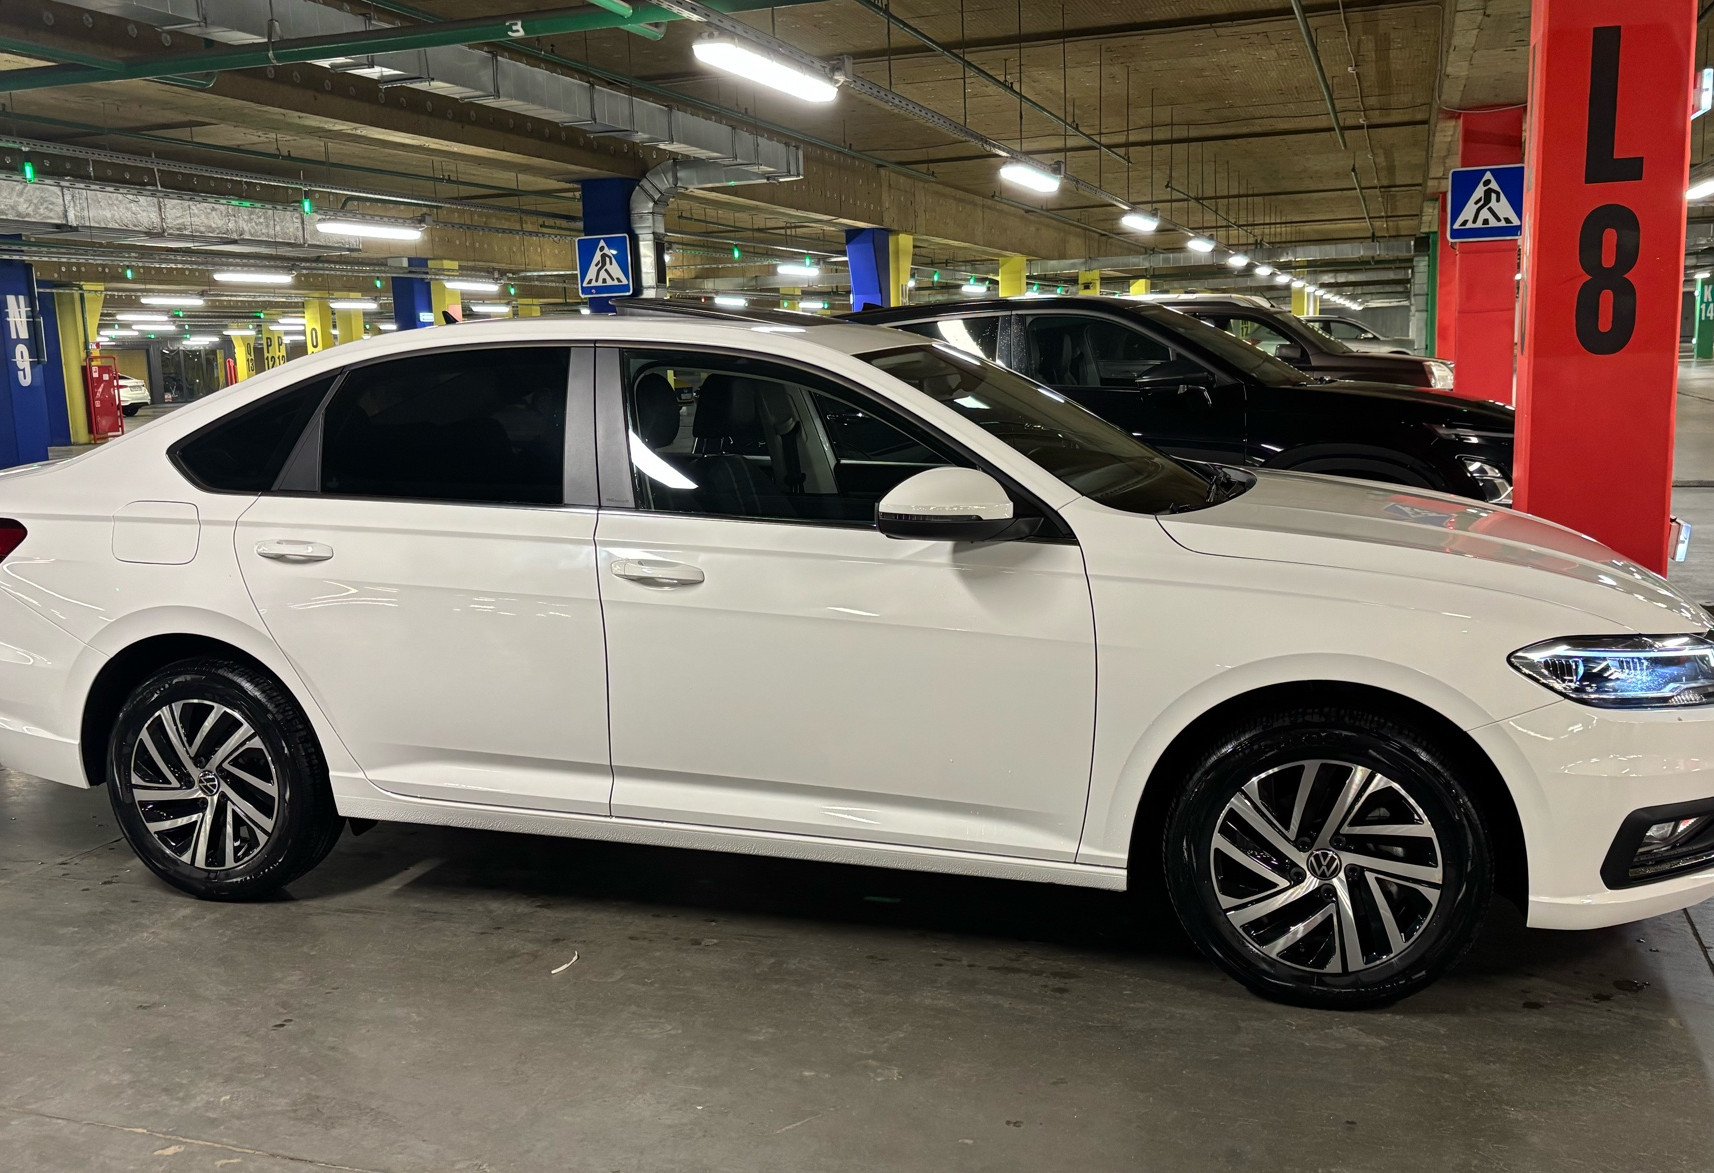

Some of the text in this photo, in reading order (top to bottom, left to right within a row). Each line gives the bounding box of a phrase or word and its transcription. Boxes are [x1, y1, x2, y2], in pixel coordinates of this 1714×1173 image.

[505, 20, 525, 37] 3
[1584, 25, 1644, 185] L
[1575, 203, 1641, 356] 8
[1703, 285, 1713, 302] K
[6, 295, 29, 339] N
[1700, 303, 1714, 320] 14
[266, 337, 272, 353] P
[278, 336, 282, 353] P
[15, 343, 32, 387] 9
[247, 358, 254, 372] 13
[1308, 849, 1341, 880] VW
